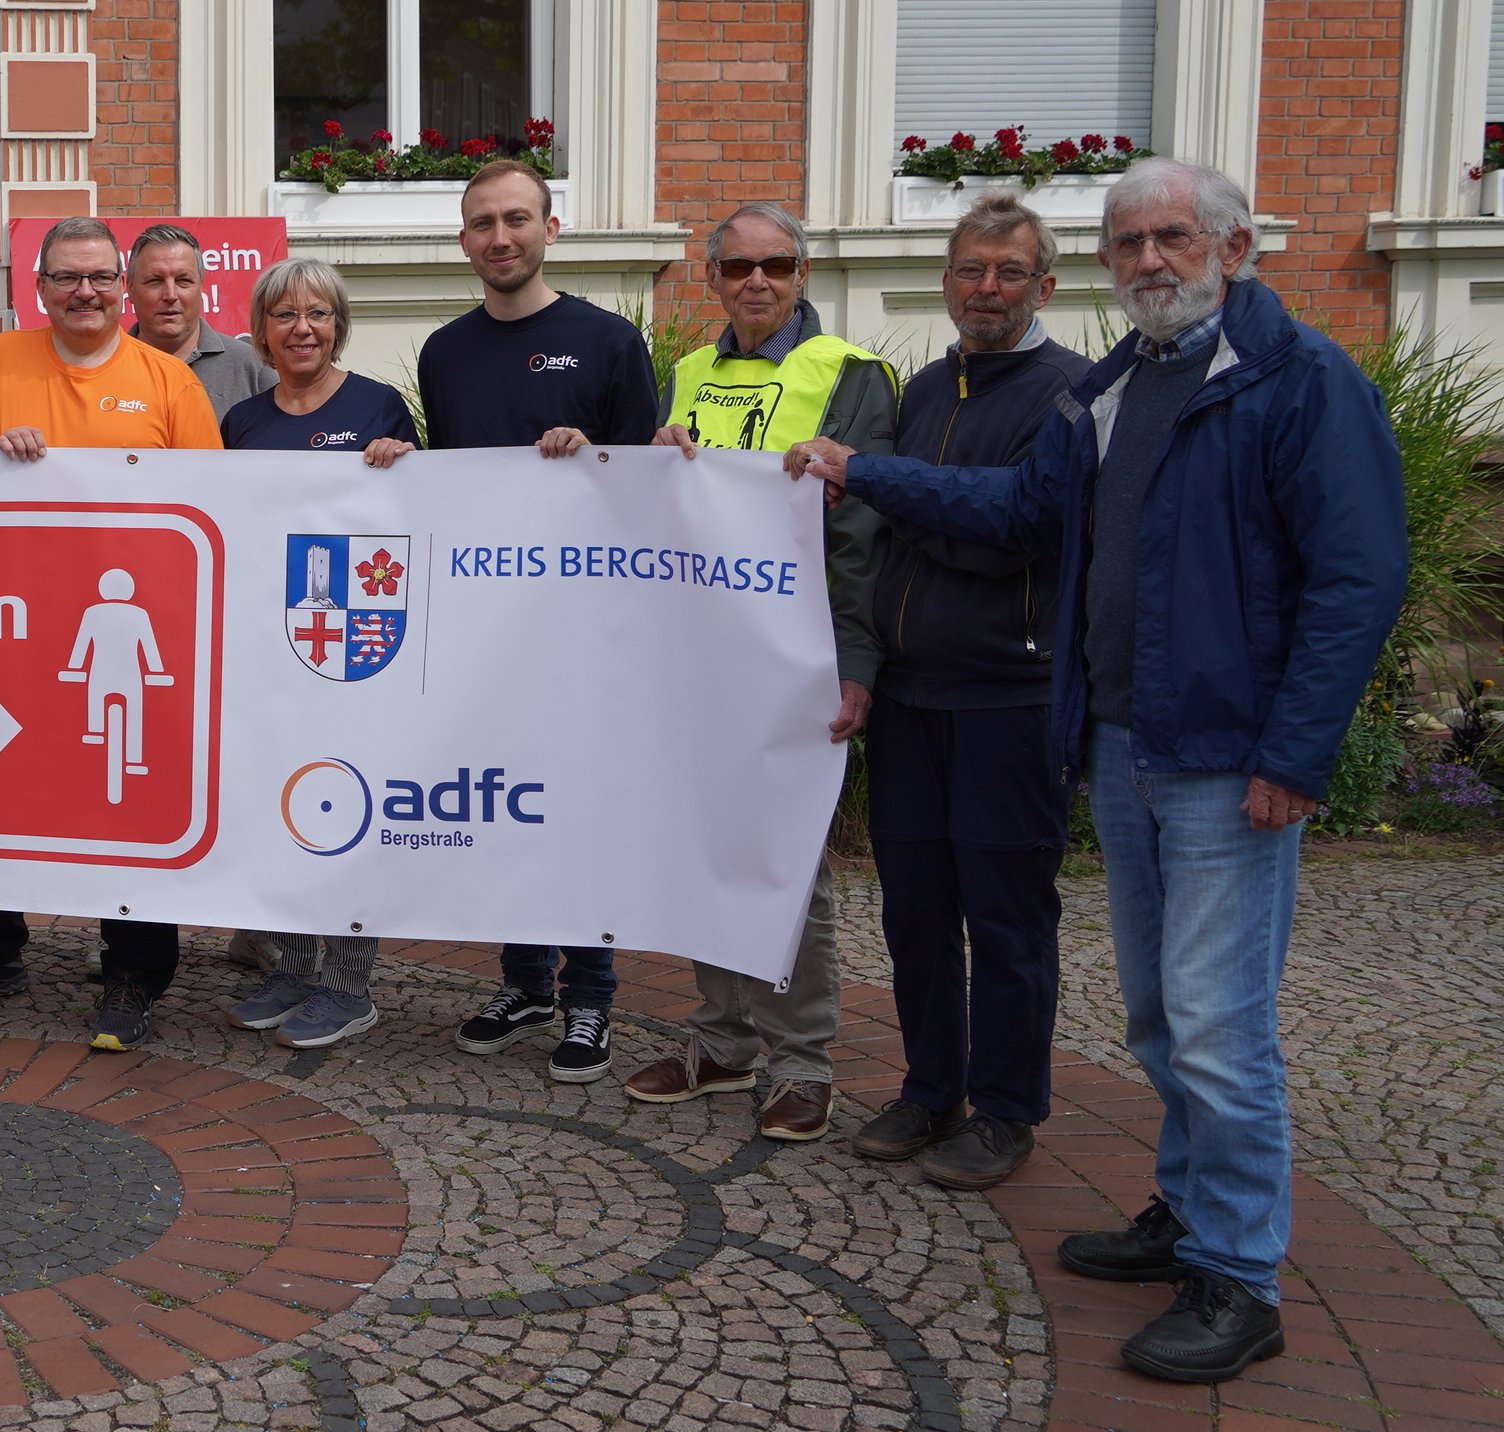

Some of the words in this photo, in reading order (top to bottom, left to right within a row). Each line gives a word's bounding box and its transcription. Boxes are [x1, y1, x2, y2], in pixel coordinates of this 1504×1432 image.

[201, 242, 262, 271] eim
[547, 355, 579, 368] adfc
[118, 399, 148, 412] adfc
[696, 389, 760, 407] Abstand!
[328, 431, 358, 441] adfc
[450, 546, 547, 579] KREIS
[560, 546, 798, 596] BERGSTRASSE
[382, 768, 545, 825] adfc
[380, 829, 475, 851] Bergstraße
